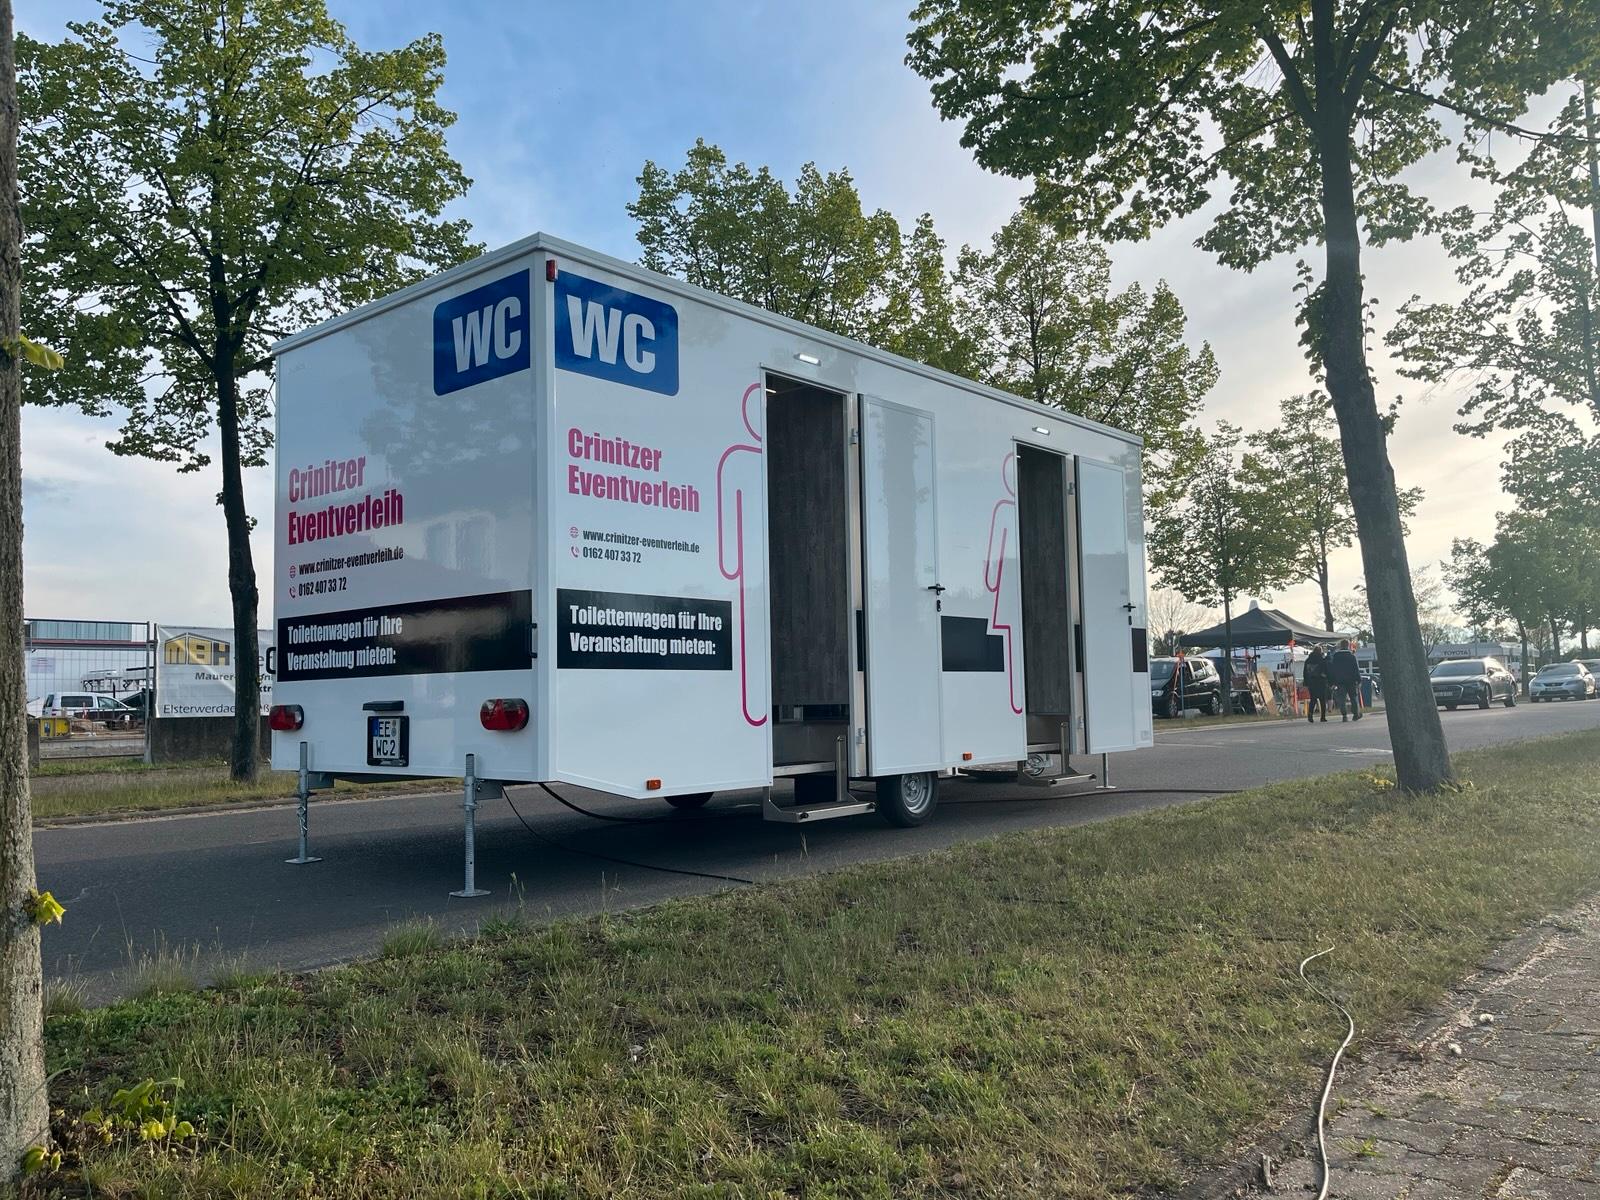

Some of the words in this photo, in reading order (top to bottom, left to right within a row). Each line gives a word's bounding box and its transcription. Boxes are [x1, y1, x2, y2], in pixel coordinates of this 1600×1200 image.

[452, 296, 522, 373] WC
[566, 294, 656, 374] WC
[568, 428, 662, 472] Crinitzer
[289, 456, 366, 502] Crinitzer
[568, 464, 700, 512] Eventverleih
[288, 488, 403, 545] Eventverleih
[583, 530, 700, 553] www.crinitzer-eventverleih.de
[583, 546, 602, 559] 0162
[604, 549, 619, 560] 407
[620, 550, 631, 562] 33
[632, 552, 641, 563] 72
[299, 546, 404, 575] www.crinitzer-eventverleih.de
[298, 583, 314, 596] 0162
[315, 581, 326, 594] 407
[328, 579, 336, 592] 33
[338, 577, 347, 591] 72
[288, 622, 361, 644] Toilettenwagen
[364, 617, 378, 637] für
[380, 616, 402, 635] Ihre
[570, 605, 676, 630] Toilettenwagen
[678, 612, 696, 630] für
[698, 612, 722, 631] Ihre
[570, 632, 667, 656] Veranstaltung
[670, 636, 716, 655] mieten:
[288, 649, 354, 671] Veranstaltung
[379, 721, 390, 737] EE
